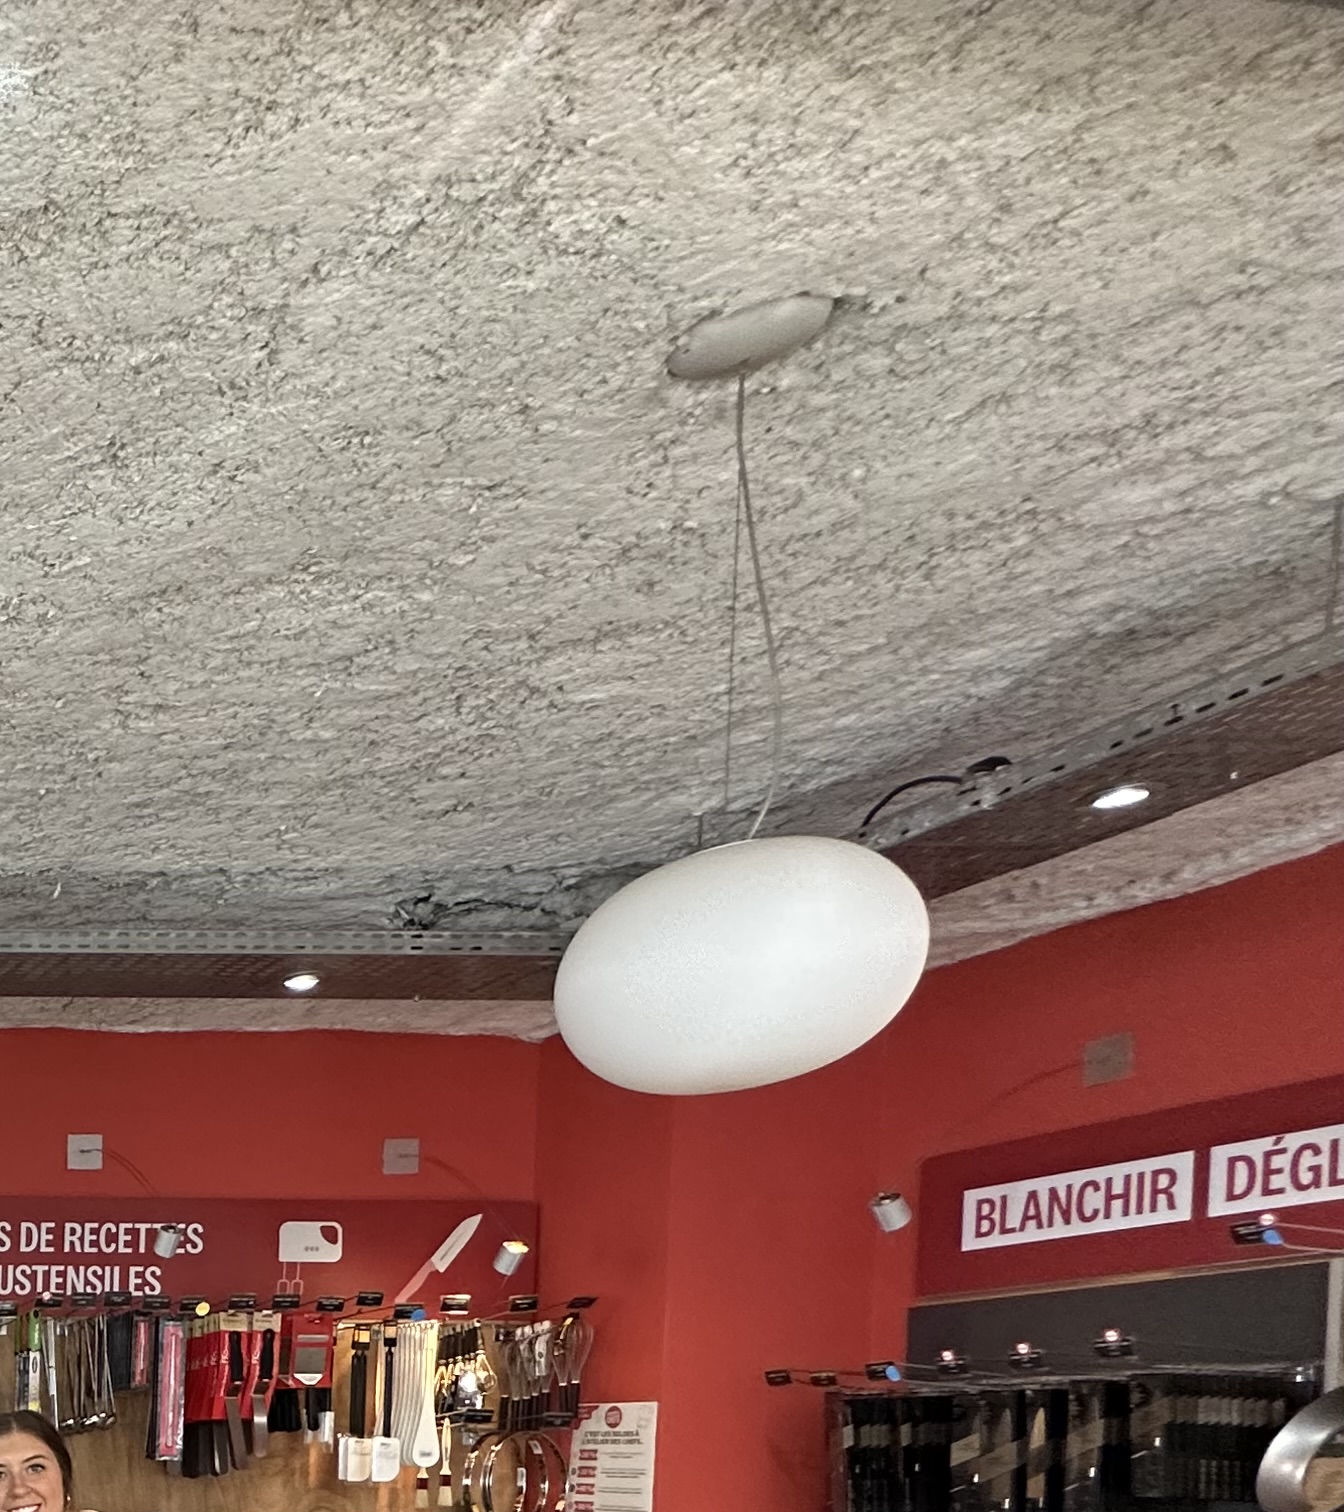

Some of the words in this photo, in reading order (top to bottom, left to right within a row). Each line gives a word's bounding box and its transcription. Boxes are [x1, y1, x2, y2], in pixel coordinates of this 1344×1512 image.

[1225, 1136, 1344, 1202] DÉGL
[974, 1167, 1178, 1239] BLANCHIR
[20, 1222, 55, 1252] DE
[64, 1222, 204, 1254] RECETS
